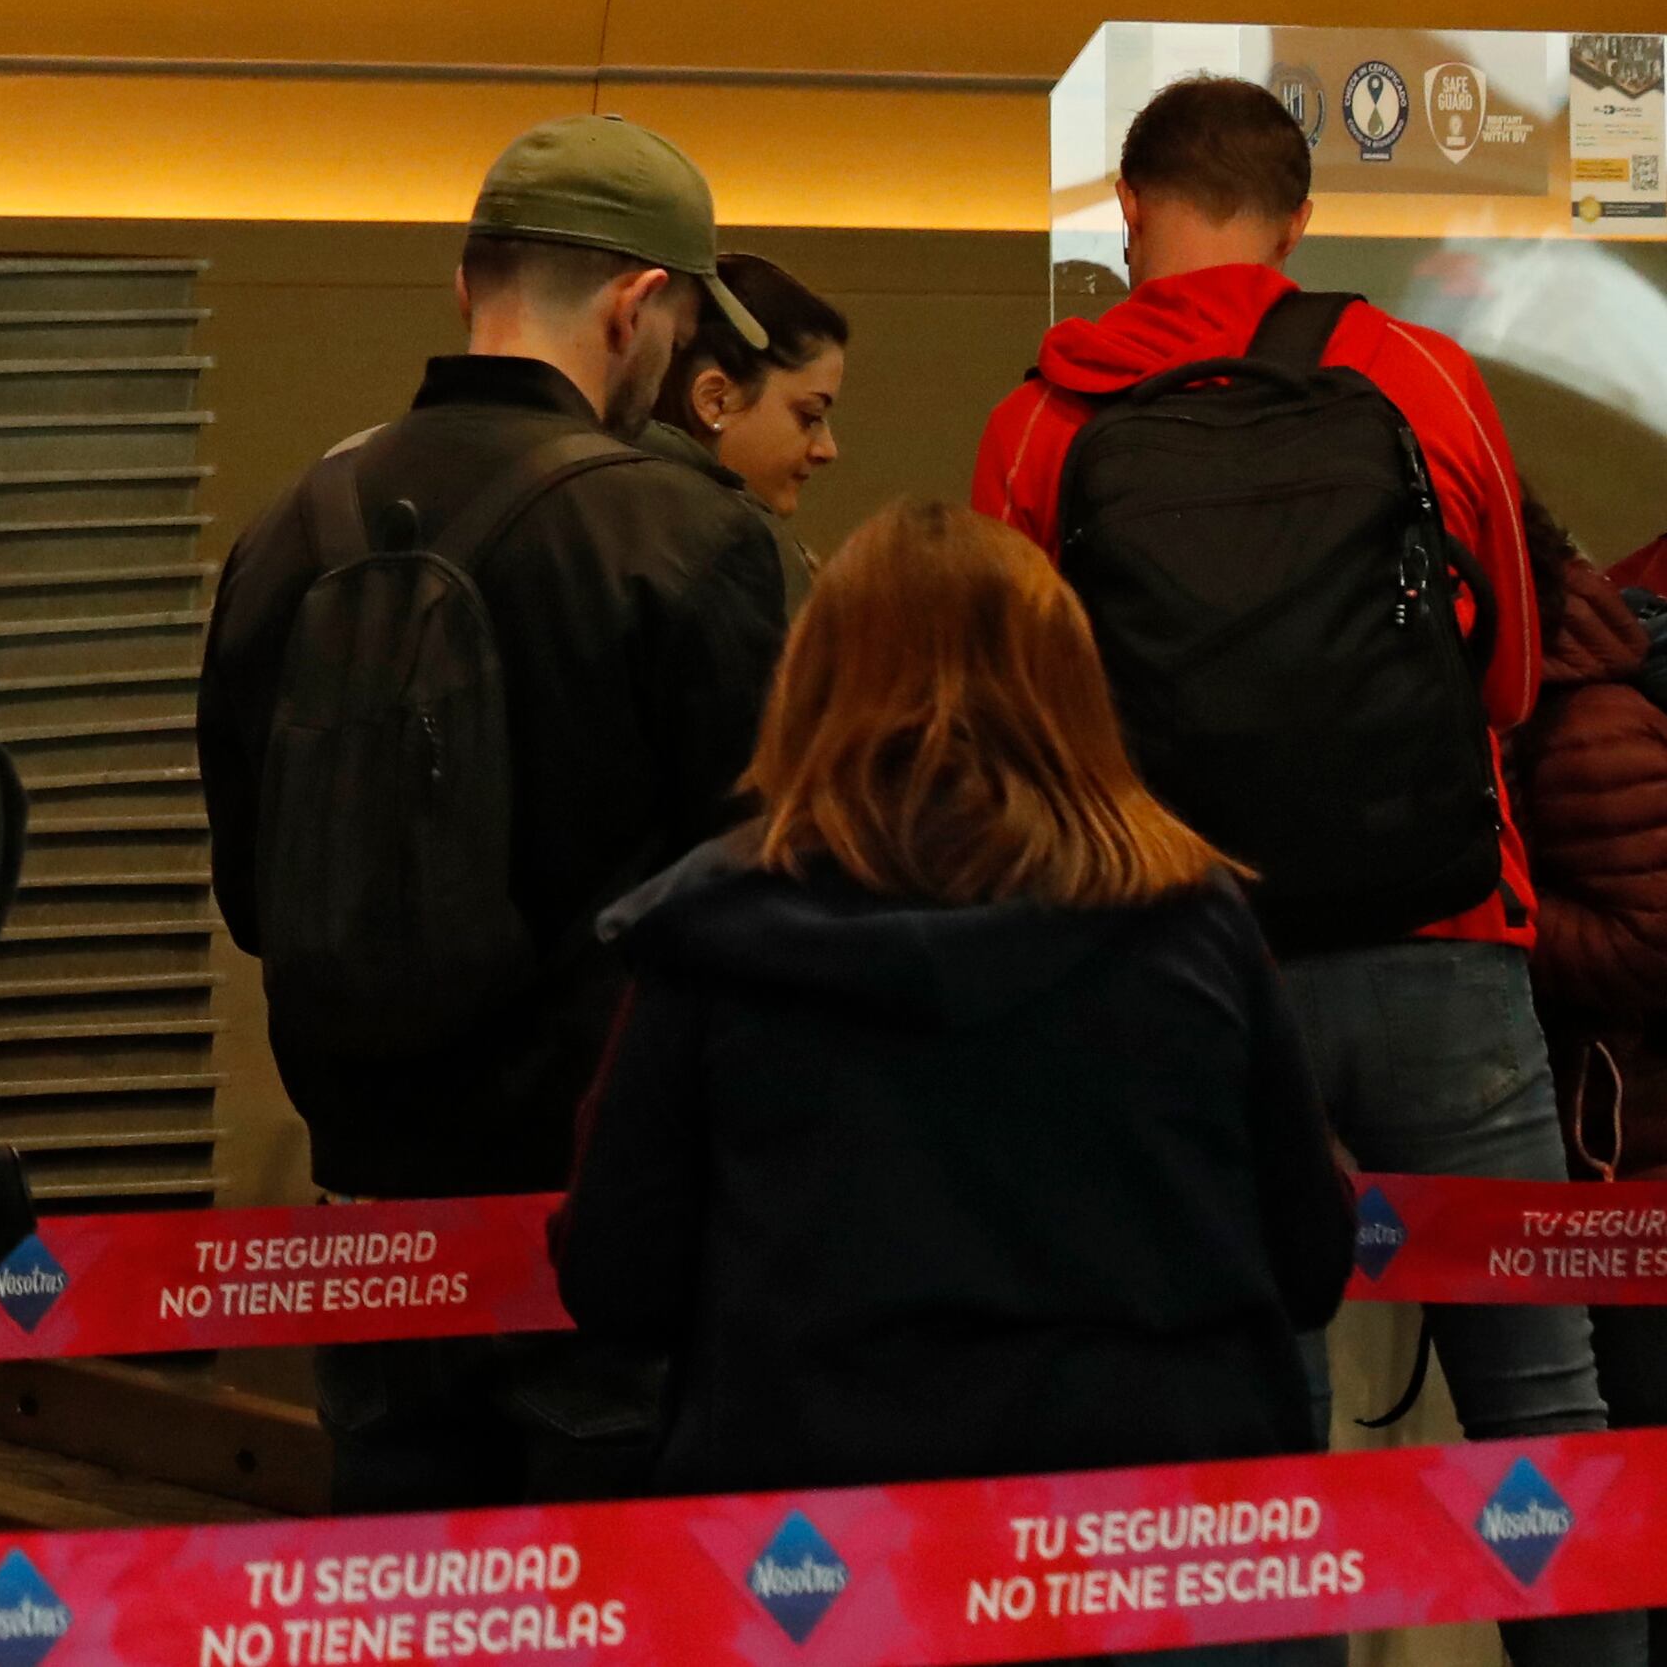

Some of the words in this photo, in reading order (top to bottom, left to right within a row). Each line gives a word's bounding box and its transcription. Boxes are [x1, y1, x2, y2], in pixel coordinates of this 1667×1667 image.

[1438, 93, 1473, 111] GUARD
[1442, 76, 1468, 93] SAFE
[196, 1241, 237, 1272] TU
[245, 1231, 437, 1271] SEGURIDAD
[1489, 1247, 1536, 1277] NO
[1542, 1248, 1627, 1277] TIENE
[1635, 1247, 1667, 1276] ES
[160, 1285, 212, 1319] NO
[219, 1280, 314, 1315] TIENE
[323, 1273, 468, 1310] ESCALAS
[1010, 1516, 1068, 1562] TU
[1075, 1497, 1322, 1557] SEGURIDAD
[244, 1560, 304, 1609] TU
[313, 1544, 581, 1606] SEGURIDAD
[967, 1576, 1035, 1624] NO
[1046, 1565, 1169, 1616] TIENE
[1175, 1550, 1365, 1608] ESCALAS
[199, 1622, 274, 1667] NO
[282, 1612, 417, 1667] TIENE
[423, 1600, 626, 1659] ESCALAS
